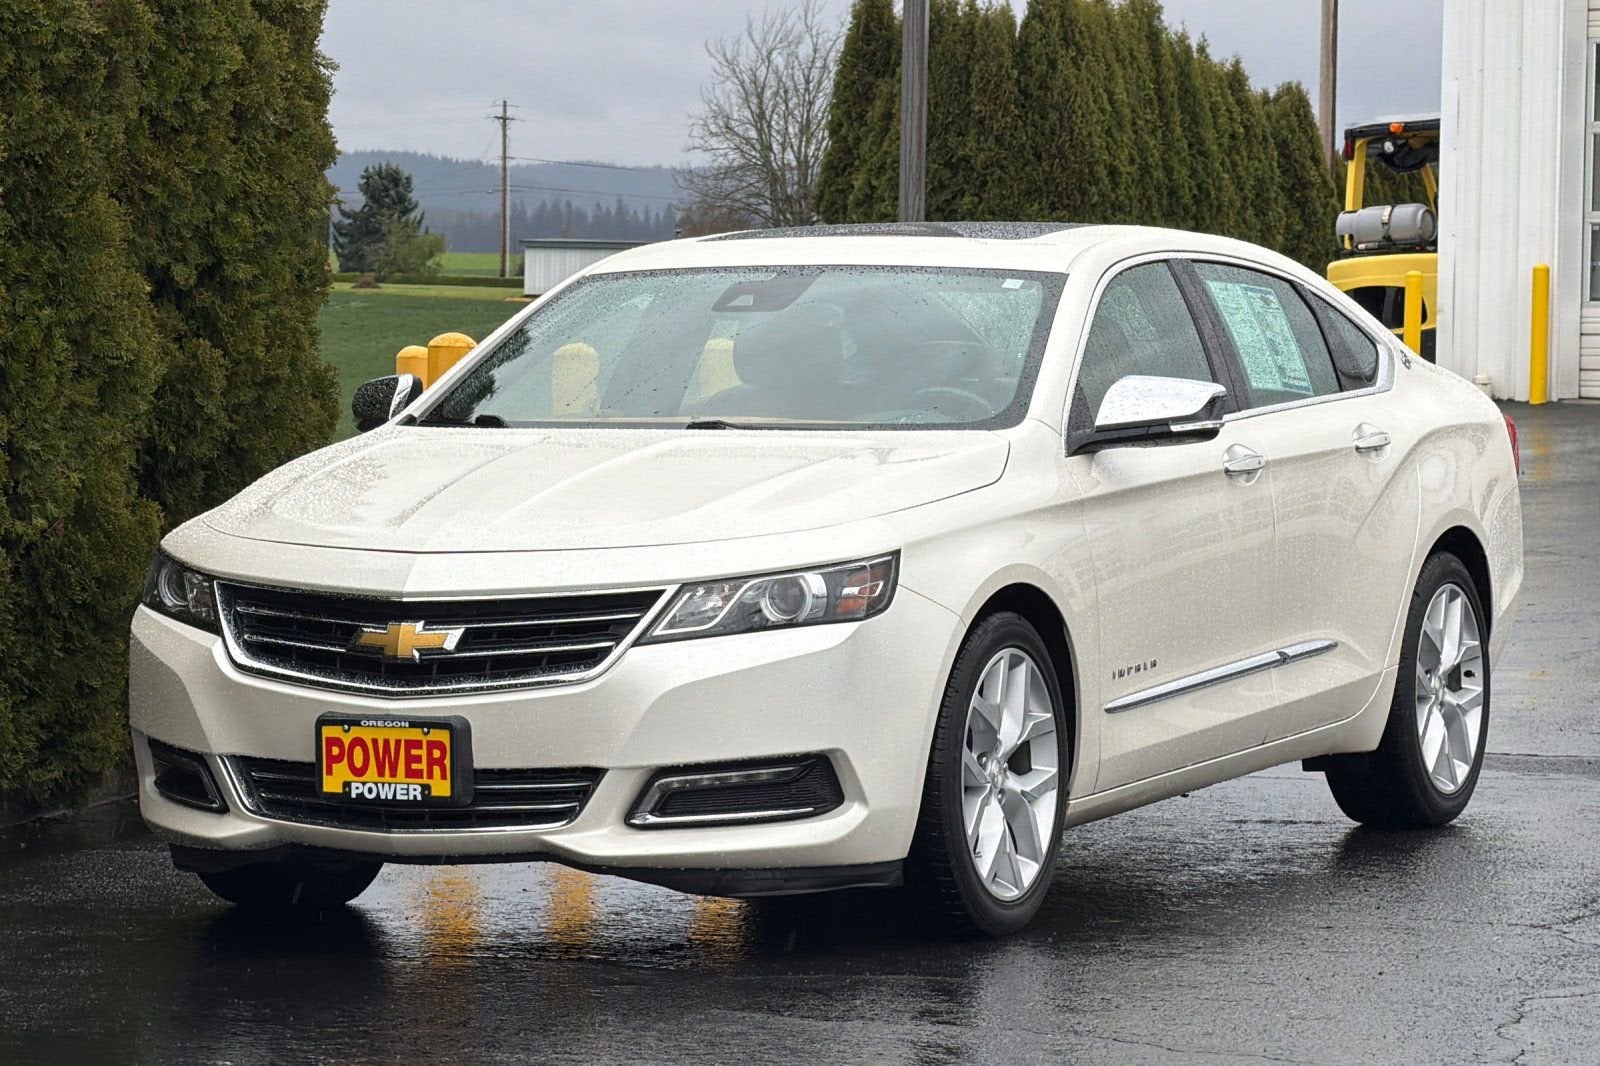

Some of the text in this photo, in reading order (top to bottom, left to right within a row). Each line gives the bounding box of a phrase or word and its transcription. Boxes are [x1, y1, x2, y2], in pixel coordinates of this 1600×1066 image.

[360, 720, 409, 728] OREGON
[324, 736, 448, 780] POWER
[350, 782, 422, 800] POWER
